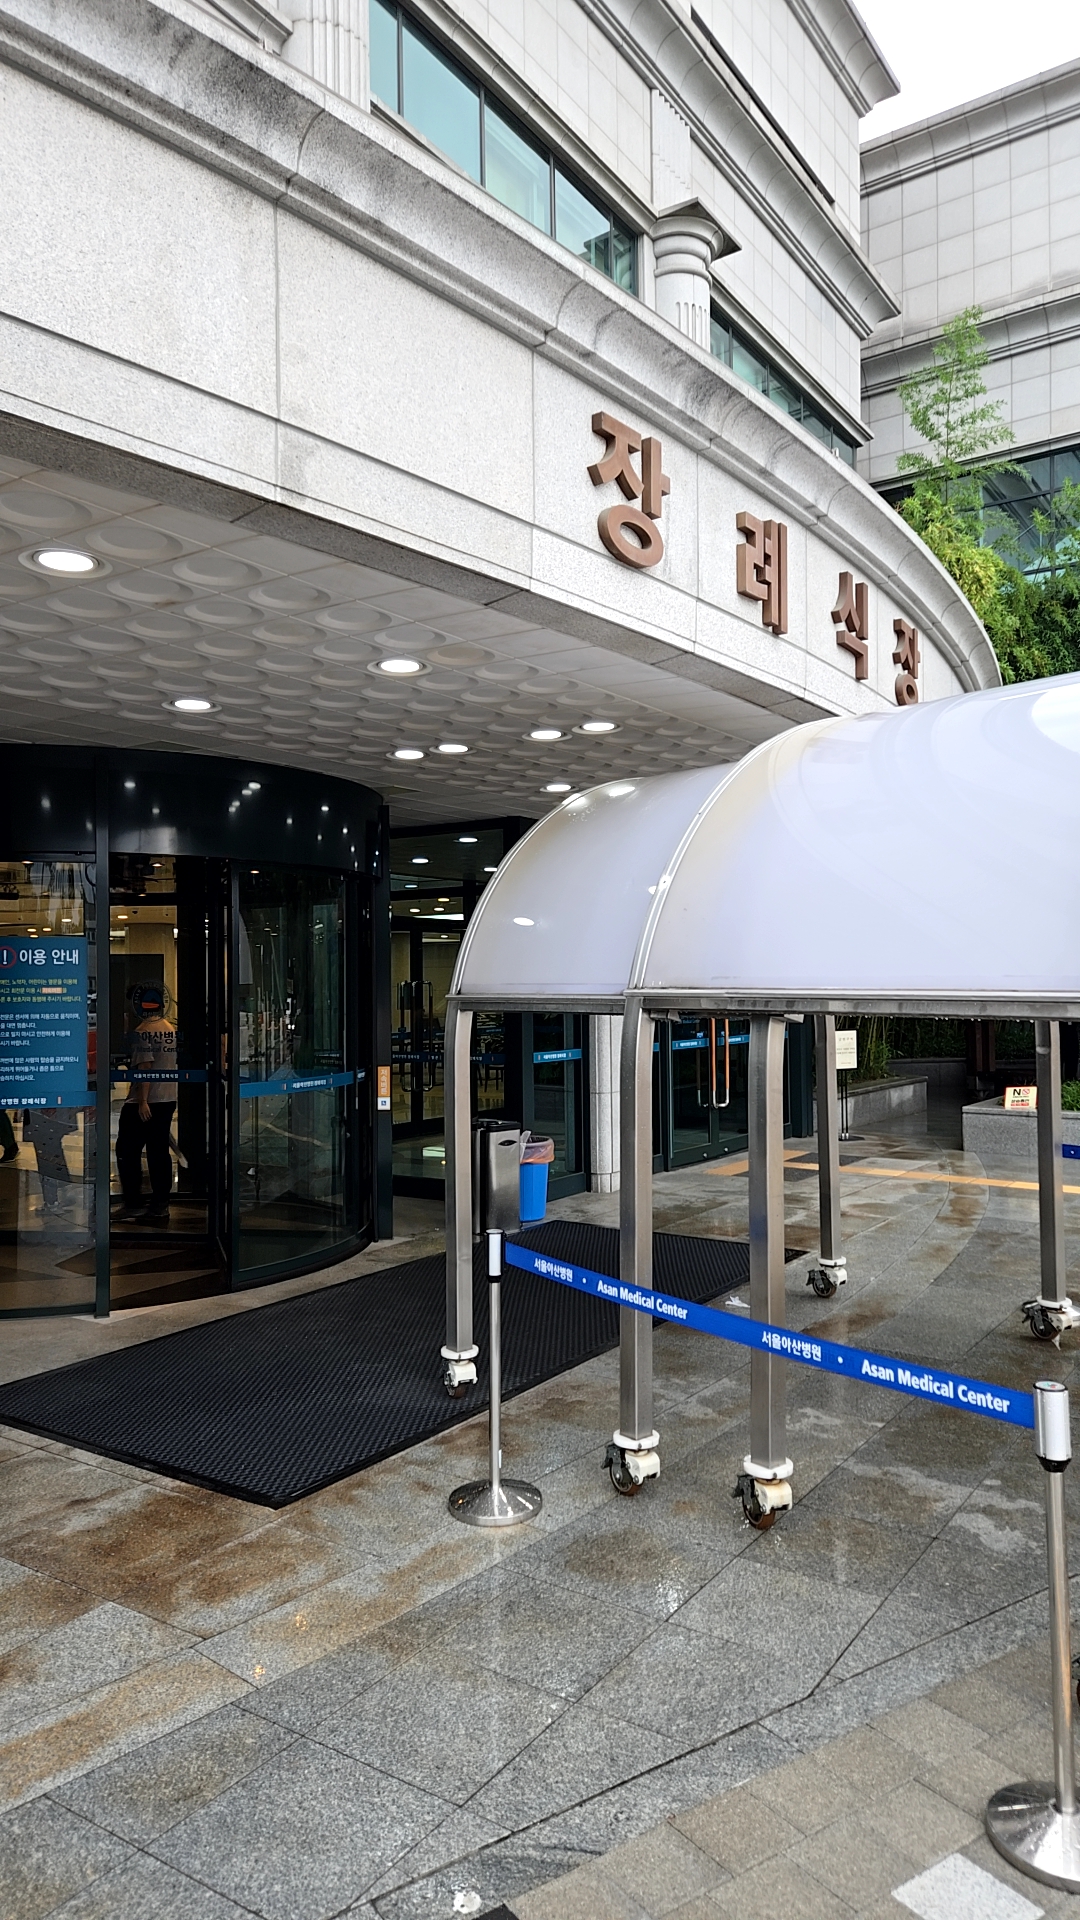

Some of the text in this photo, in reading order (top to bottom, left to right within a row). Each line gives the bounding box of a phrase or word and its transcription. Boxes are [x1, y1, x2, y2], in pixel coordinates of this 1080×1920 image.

[587, 411, 920, 706] 장례식장
[19, 948, 79, 965] 이용 안내
[534, 1257, 573, 1283] 서울아산병원
[597, 1279, 688, 1320] Asan Medical Center
[762, 1331, 822, 1362] 서울아산병원
[861, 1359, 1010, 1413] Asan Medical Center
